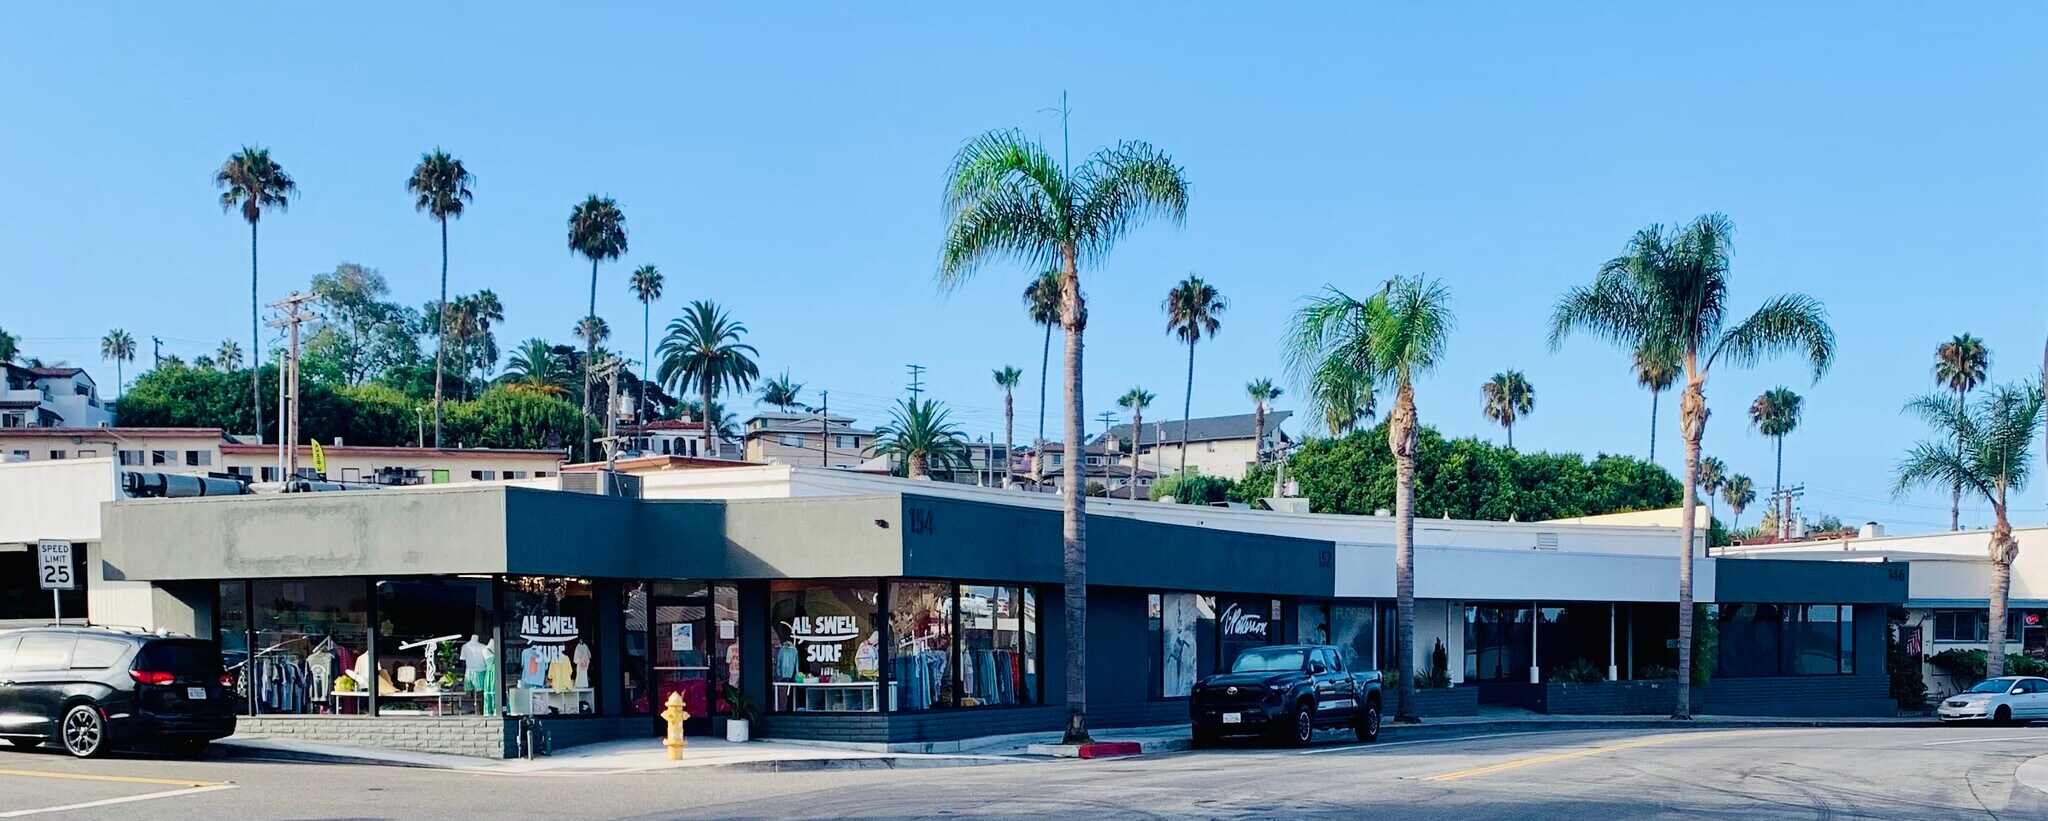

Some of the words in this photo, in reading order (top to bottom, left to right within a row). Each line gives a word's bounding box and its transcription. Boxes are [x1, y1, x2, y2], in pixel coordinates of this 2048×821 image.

[908, 508, 933, 534] 154
[41, 544, 69, 553] SPEED
[45, 555, 66, 563] LIMIT
[44, 565, 70, 583] 25
[521, 615, 539, 634] ALL
[541, 615, 579, 634] SWELL
[791, 616, 812, 634] ALL
[814, 615, 859, 635] SWELL
[535, 645, 566, 663] SURF
[806, 644, 843, 662] SURF
